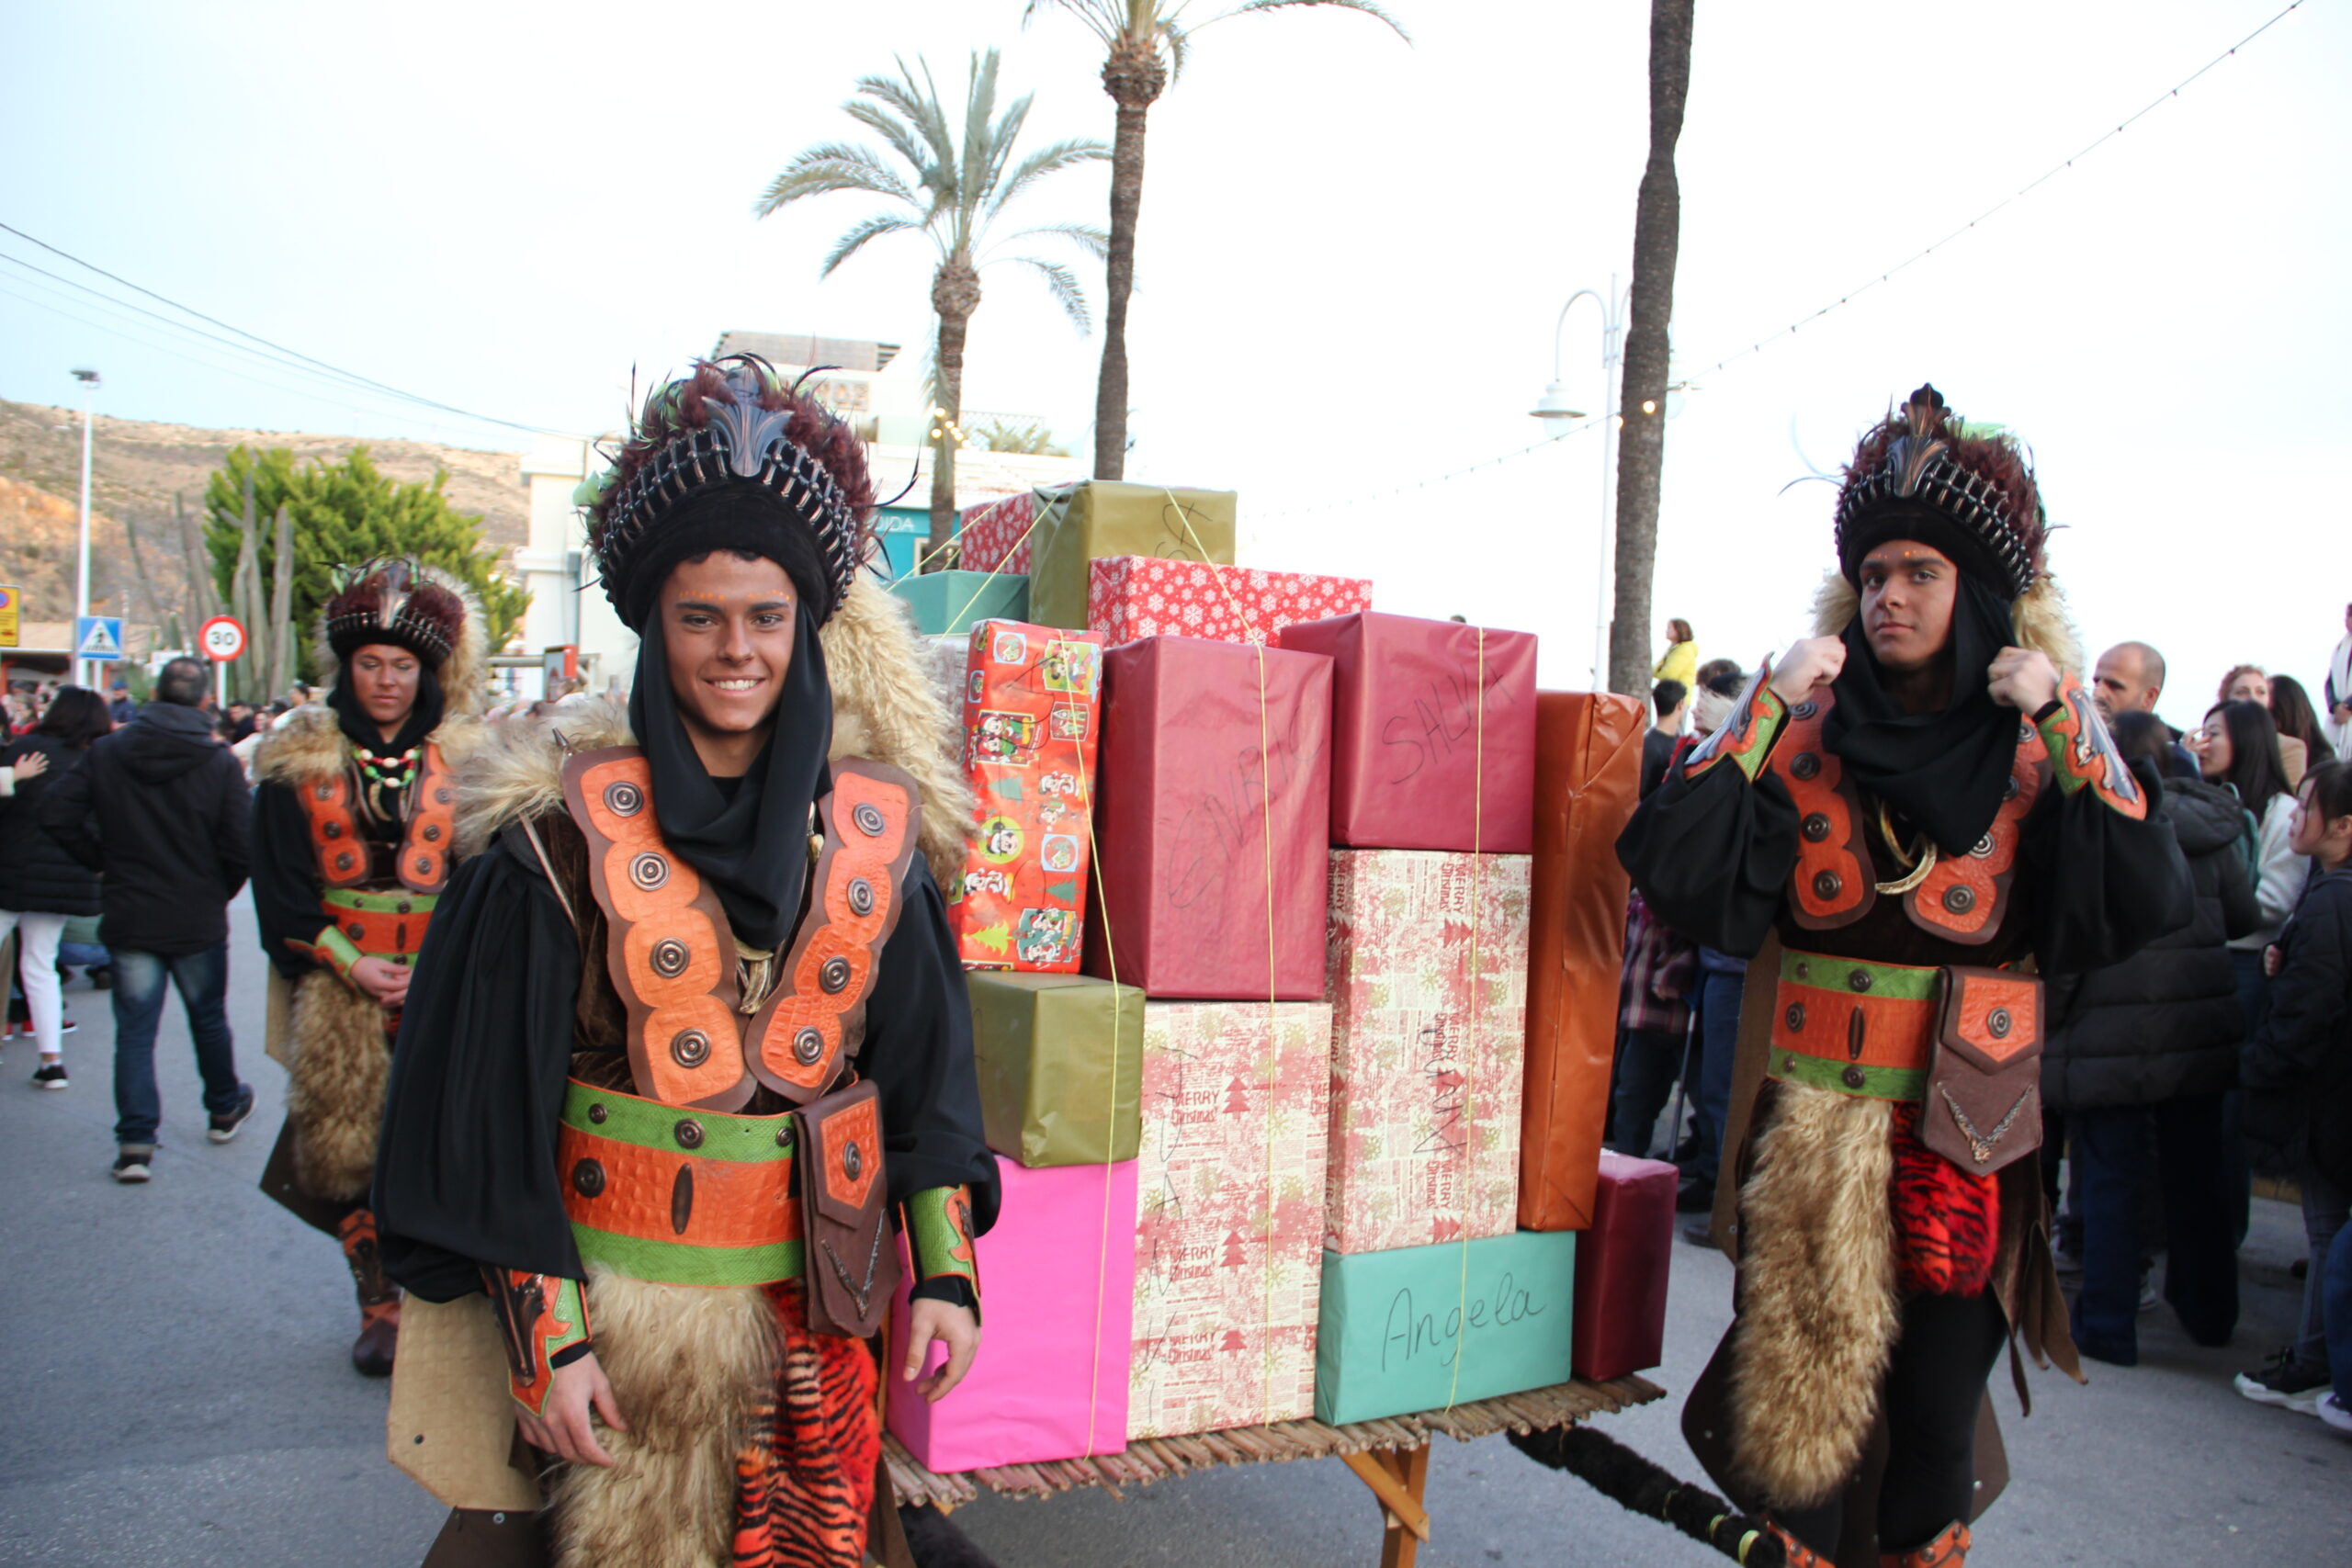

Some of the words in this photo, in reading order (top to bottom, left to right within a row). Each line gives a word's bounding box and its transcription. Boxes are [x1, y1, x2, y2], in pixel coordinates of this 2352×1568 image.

[209, 630, 236, 647] 30
[1381, 660, 1516, 785] SALVA
[1453, 863, 1466, 915] MERRY
[1447, 1012, 1460, 1063] MERRY
[1173, 1089, 1220, 1107] MERRY
[1441, 1159, 1453, 1210] MERRY
[1170, 1244, 1217, 1263] MERRY
[1382, 1272, 1548, 1372] Angela
